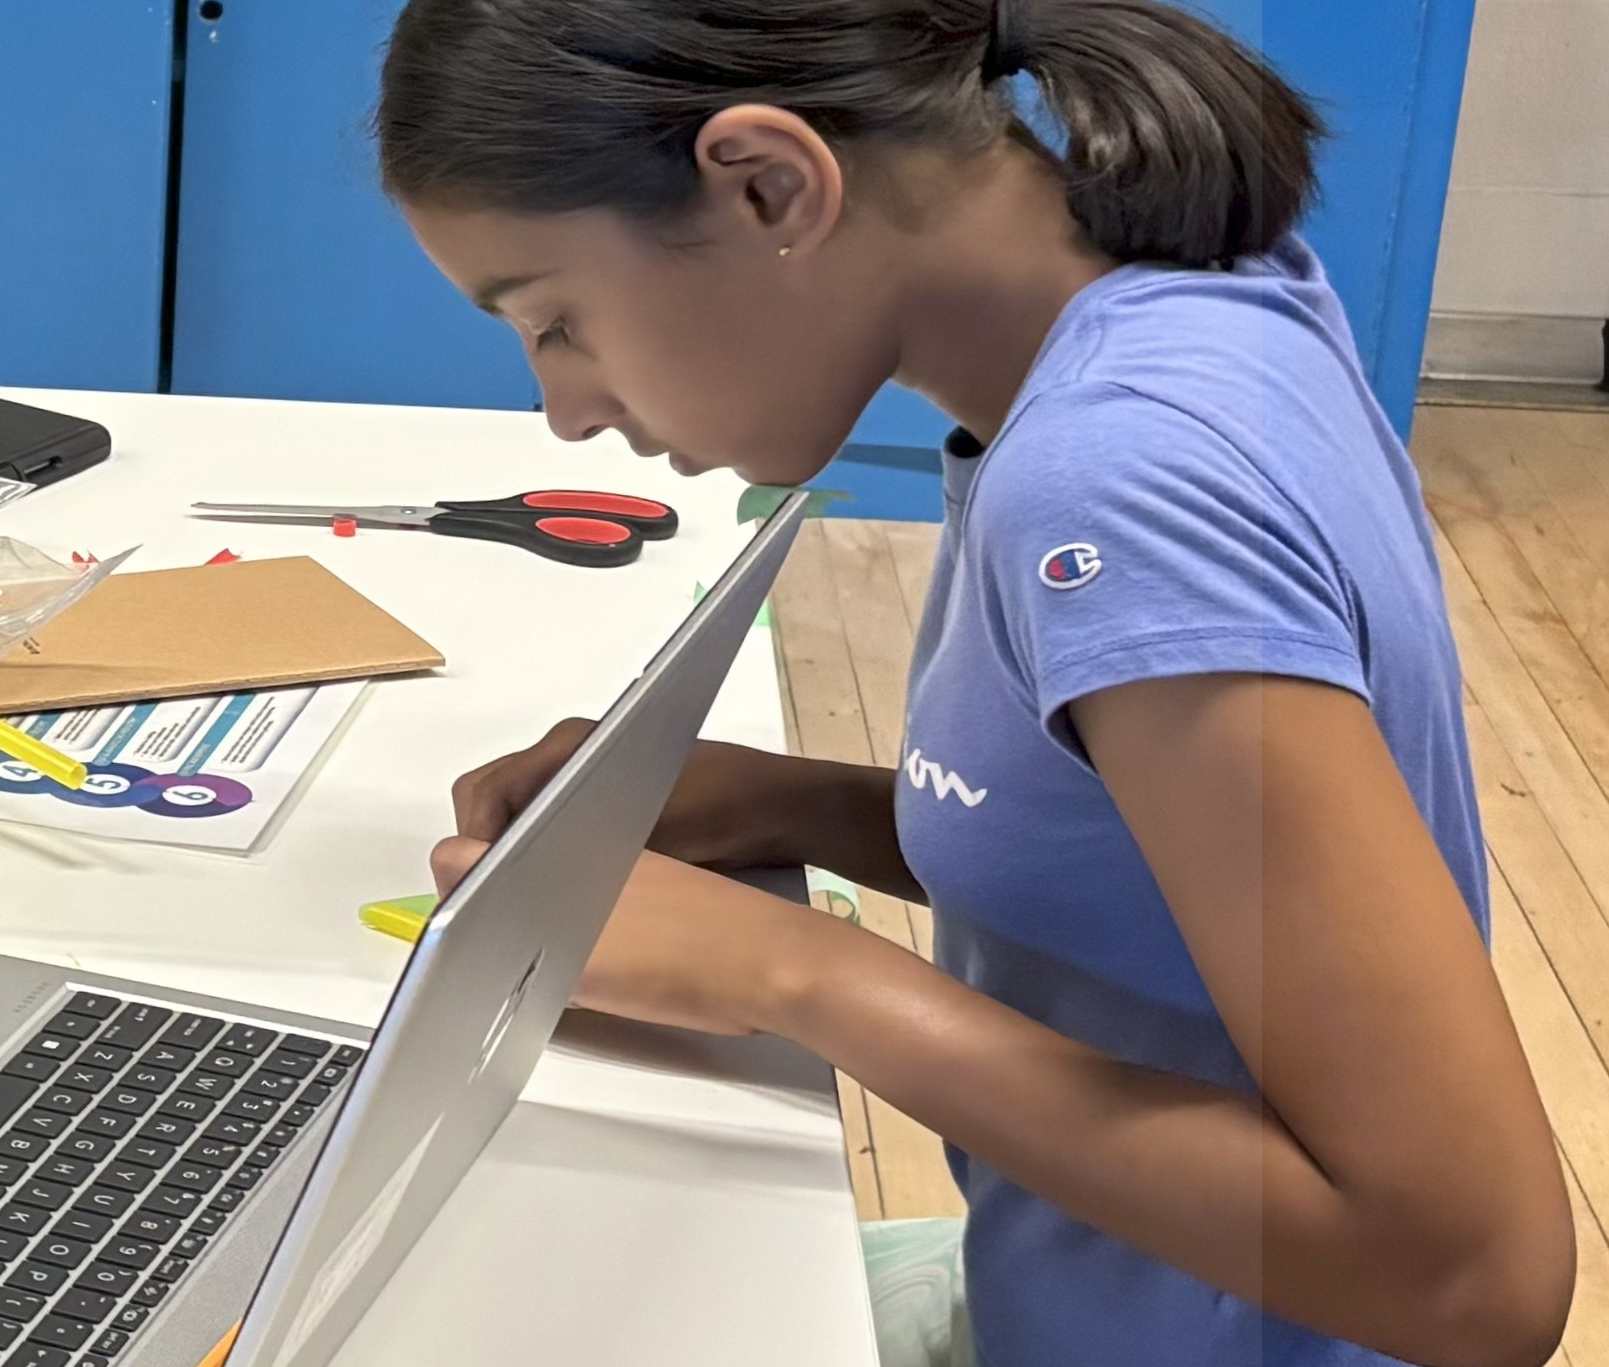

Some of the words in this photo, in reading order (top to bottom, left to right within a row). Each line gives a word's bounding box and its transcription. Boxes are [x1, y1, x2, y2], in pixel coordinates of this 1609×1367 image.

[93, 1050, 114, 1061] Z
[155, 1050, 175, 1060] A
[214, 1056, 235, 1067] Q
[73, 1072, 94, 1083] X
[136, 1072, 156, 1082] S
[194, 1077, 218, 1091] W
[260, 1079, 278, 1089] 2
[52, 1094, 73, 1105] C
[117, 1093, 138, 1104] D
[175, 1100, 196, 1110] E
[242, 1101, 260, 1111] 3
[32, 1117, 53, 1128] V
[99, 1116, 117, 1127] F
[155, 1122, 177, 1133] R
[10, 1139, 31, 1150] B
[74, 1140, 95, 1151] G
[136, 1148, 157, 1157] T
[202, 1147, 220, 1156] 5
[53, 1163, 75, 1175] H
[115, 1171, 136, 1181] Y
[182, 1171, 200, 1180] 6
[31, 1188, 50, 1198] J
[93, 1194, 115, 1206] U
[163, 1196, 181, 1205] 7
[8, 1211, 31, 1223] K
[139, 1220, 159, 1230] 8
[49, 1244, 70, 1256] O
[119, 1246, 137, 1256] 9
[29, 1270, 49, 1282] P
[96, 1271, 116, 1282] 0
